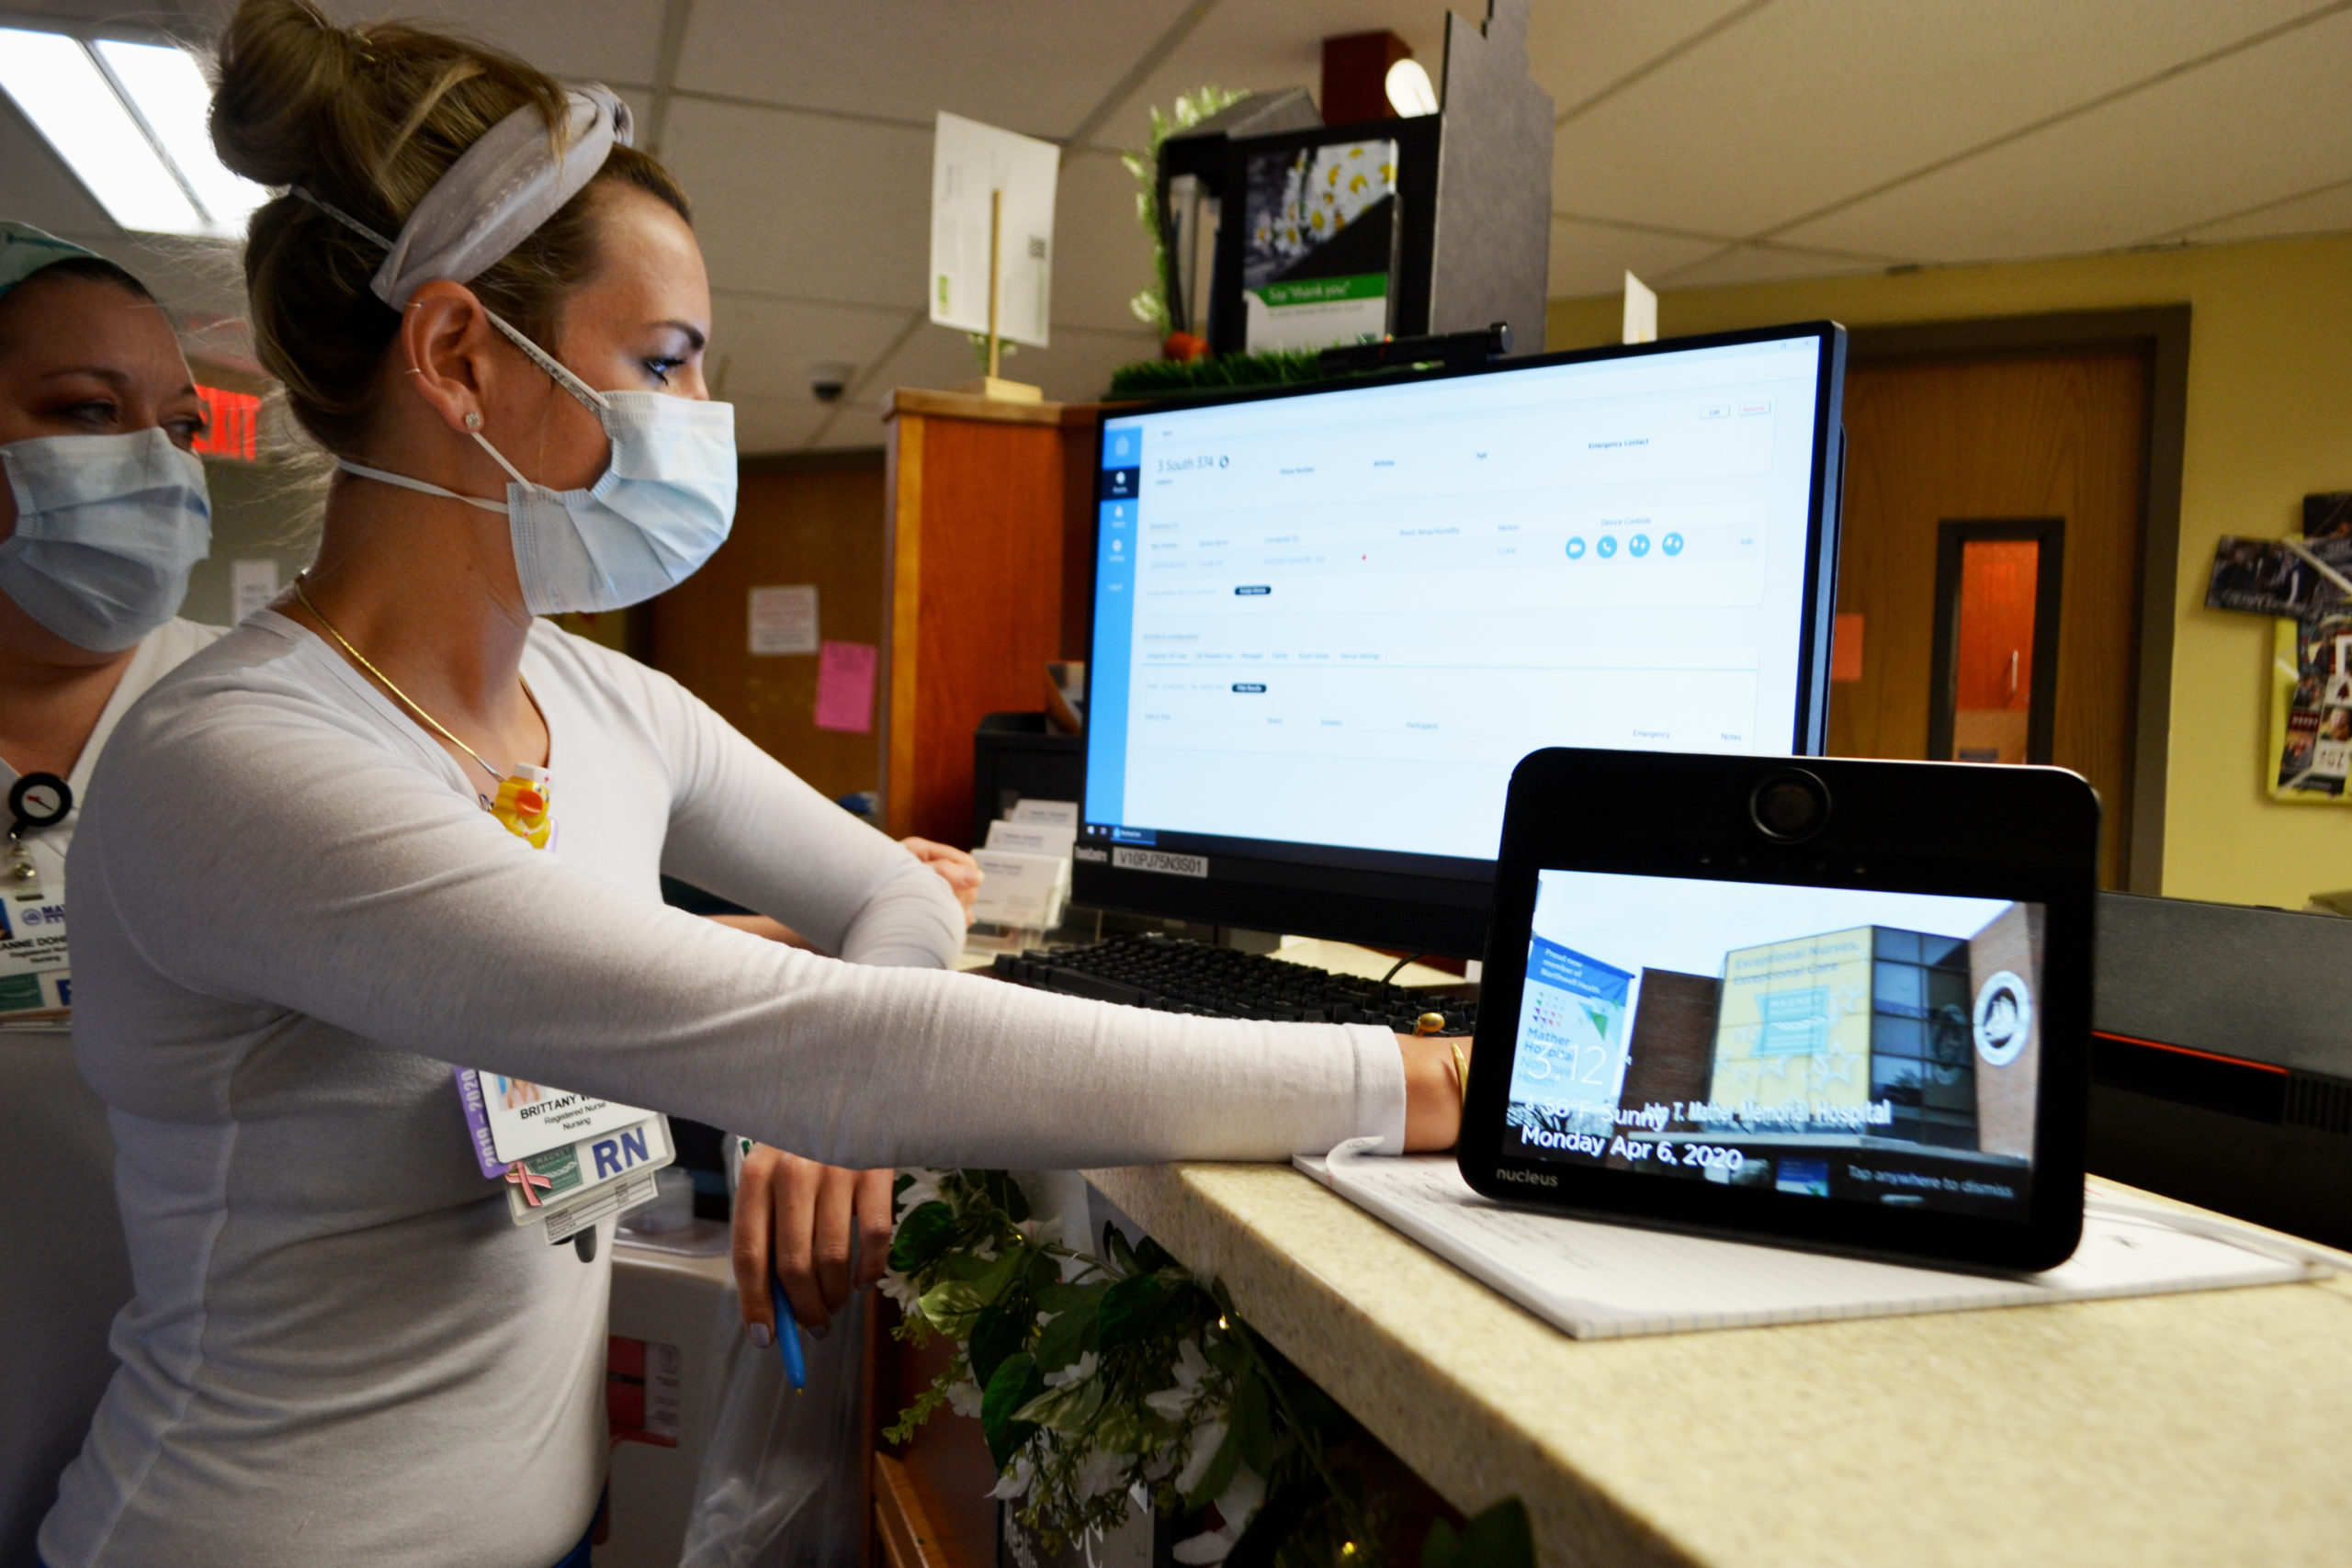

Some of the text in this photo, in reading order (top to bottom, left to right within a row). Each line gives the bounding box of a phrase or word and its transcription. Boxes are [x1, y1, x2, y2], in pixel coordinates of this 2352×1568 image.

[1588, 437, 1649, 451] Emergency Contact
[1166, 457, 1194, 471] South
[1600, 517, 1623, 526] Device
[1633, 728, 1670, 740] Emergency
[1721, 731, 1743, 742] Notes
[1543, 959, 1574, 975] member
[1544, 948, 1582, 968] Proud new
[1735, 948, 1805, 970] Exceptional
[1540, 967, 1601, 995] Northwell Health
[1733, 962, 1838, 986] Exceptional Care
[1527, 1026, 1571, 1046] Mather
[520, 1094, 577, 1120] BRITTANY
[544, 1100, 607, 1125] Registered Nurse
[1602, 1102, 1670, 1133] Sunny
[1815, 1099, 1892, 1126] Hospital
[562, 1117, 592, 1131] Nursing
[592, 1126, 650, 1179] RN
[1521, 1124, 1744, 1171] Monday Apr 6, 2020
[1496, 1167, 1559, 1188] nucleus
[1848, 1164, 2016, 1199] Tap anywhere to dismiss
